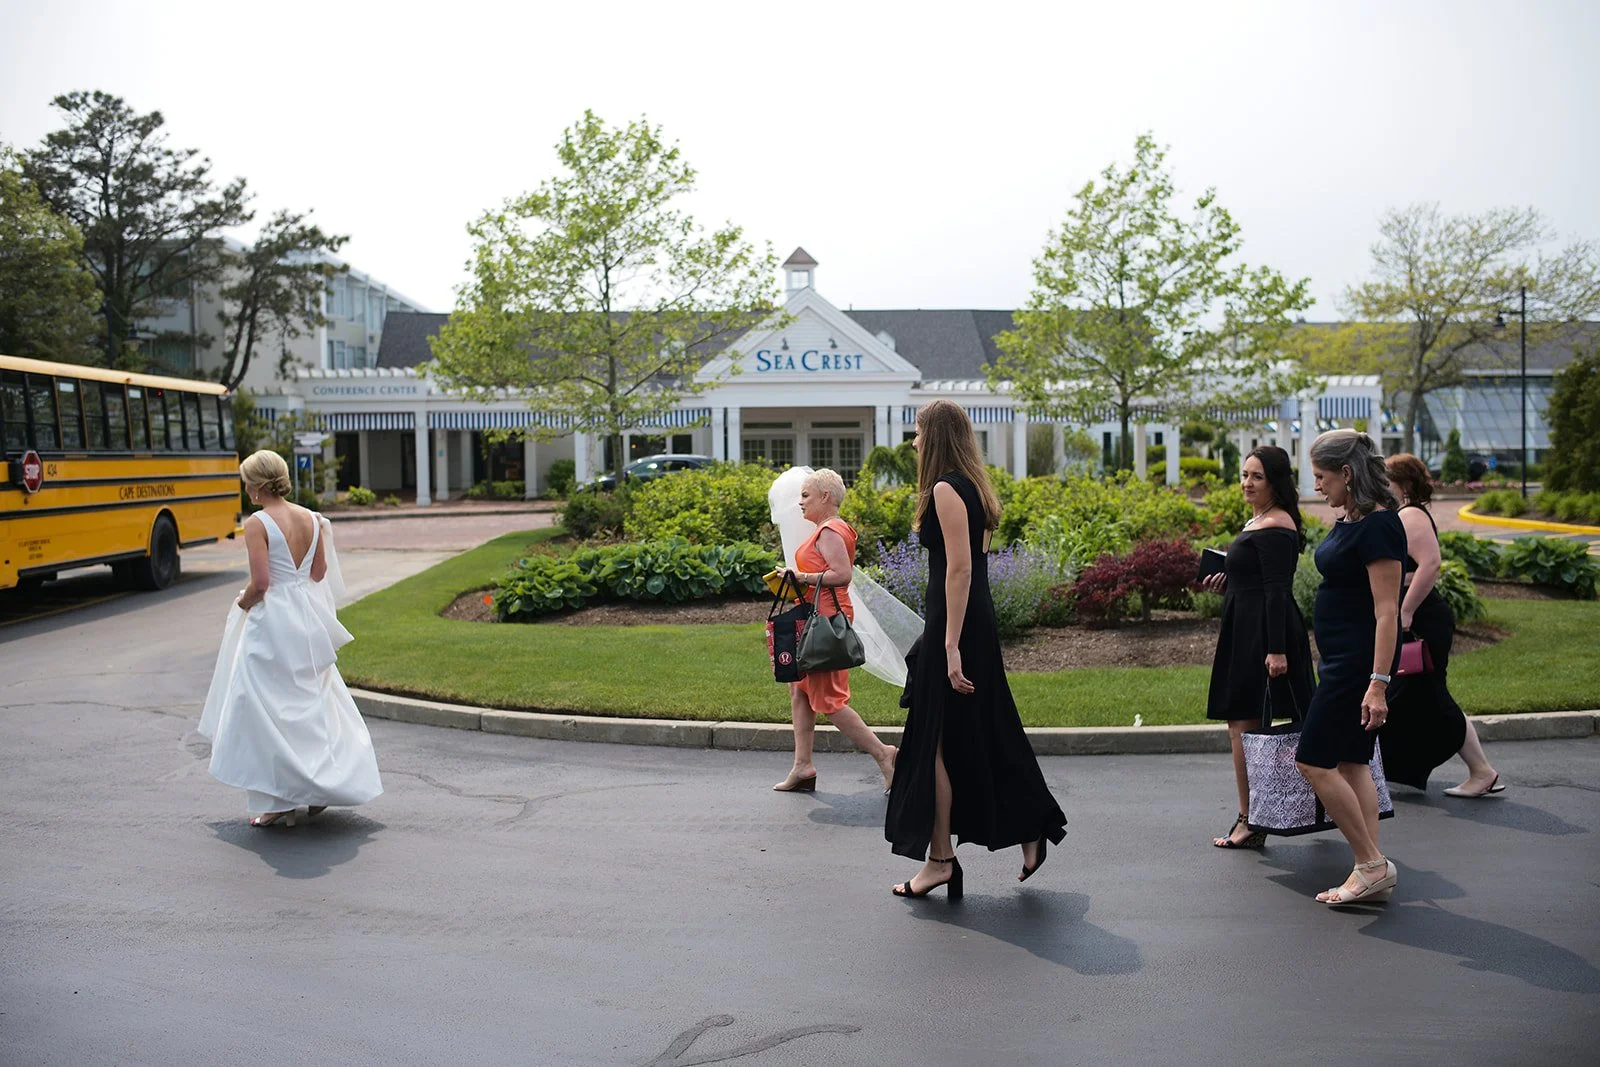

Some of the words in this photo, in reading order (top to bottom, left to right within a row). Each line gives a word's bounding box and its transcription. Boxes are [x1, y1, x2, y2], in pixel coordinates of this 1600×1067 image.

[756, 349, 796, 372] SEA
[801, 349, 863, 372] CREST
[312, 385, 376, 396] CONFERENCE
[379, 384, 417, 395] CENTER
[300, 456, 308, 469] 7
[25, 463, 40, 480] STOP
[119, 485, 135, 500] CAPE
[136, 482, 176, 499] DESTINATIONS
